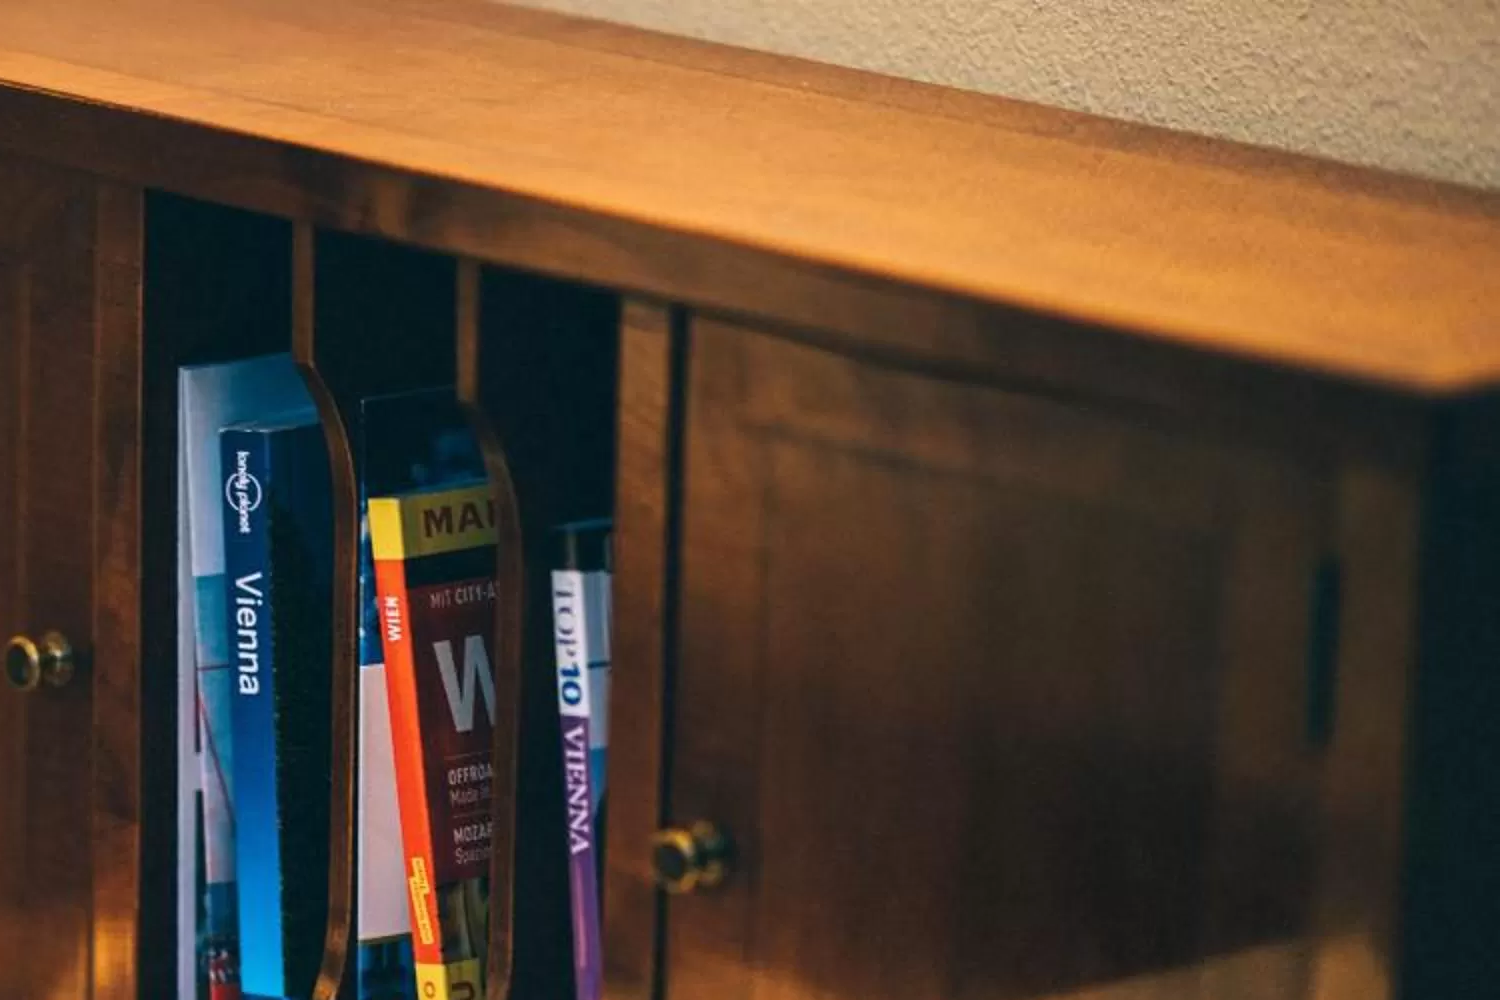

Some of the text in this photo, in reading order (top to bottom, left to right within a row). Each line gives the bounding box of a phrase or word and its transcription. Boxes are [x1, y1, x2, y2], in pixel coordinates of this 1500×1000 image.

[235, 571, 263, 695] Vienna
[385, 596, 402, 642] WIEN
[564, 724, 591, 856] VIENNA
